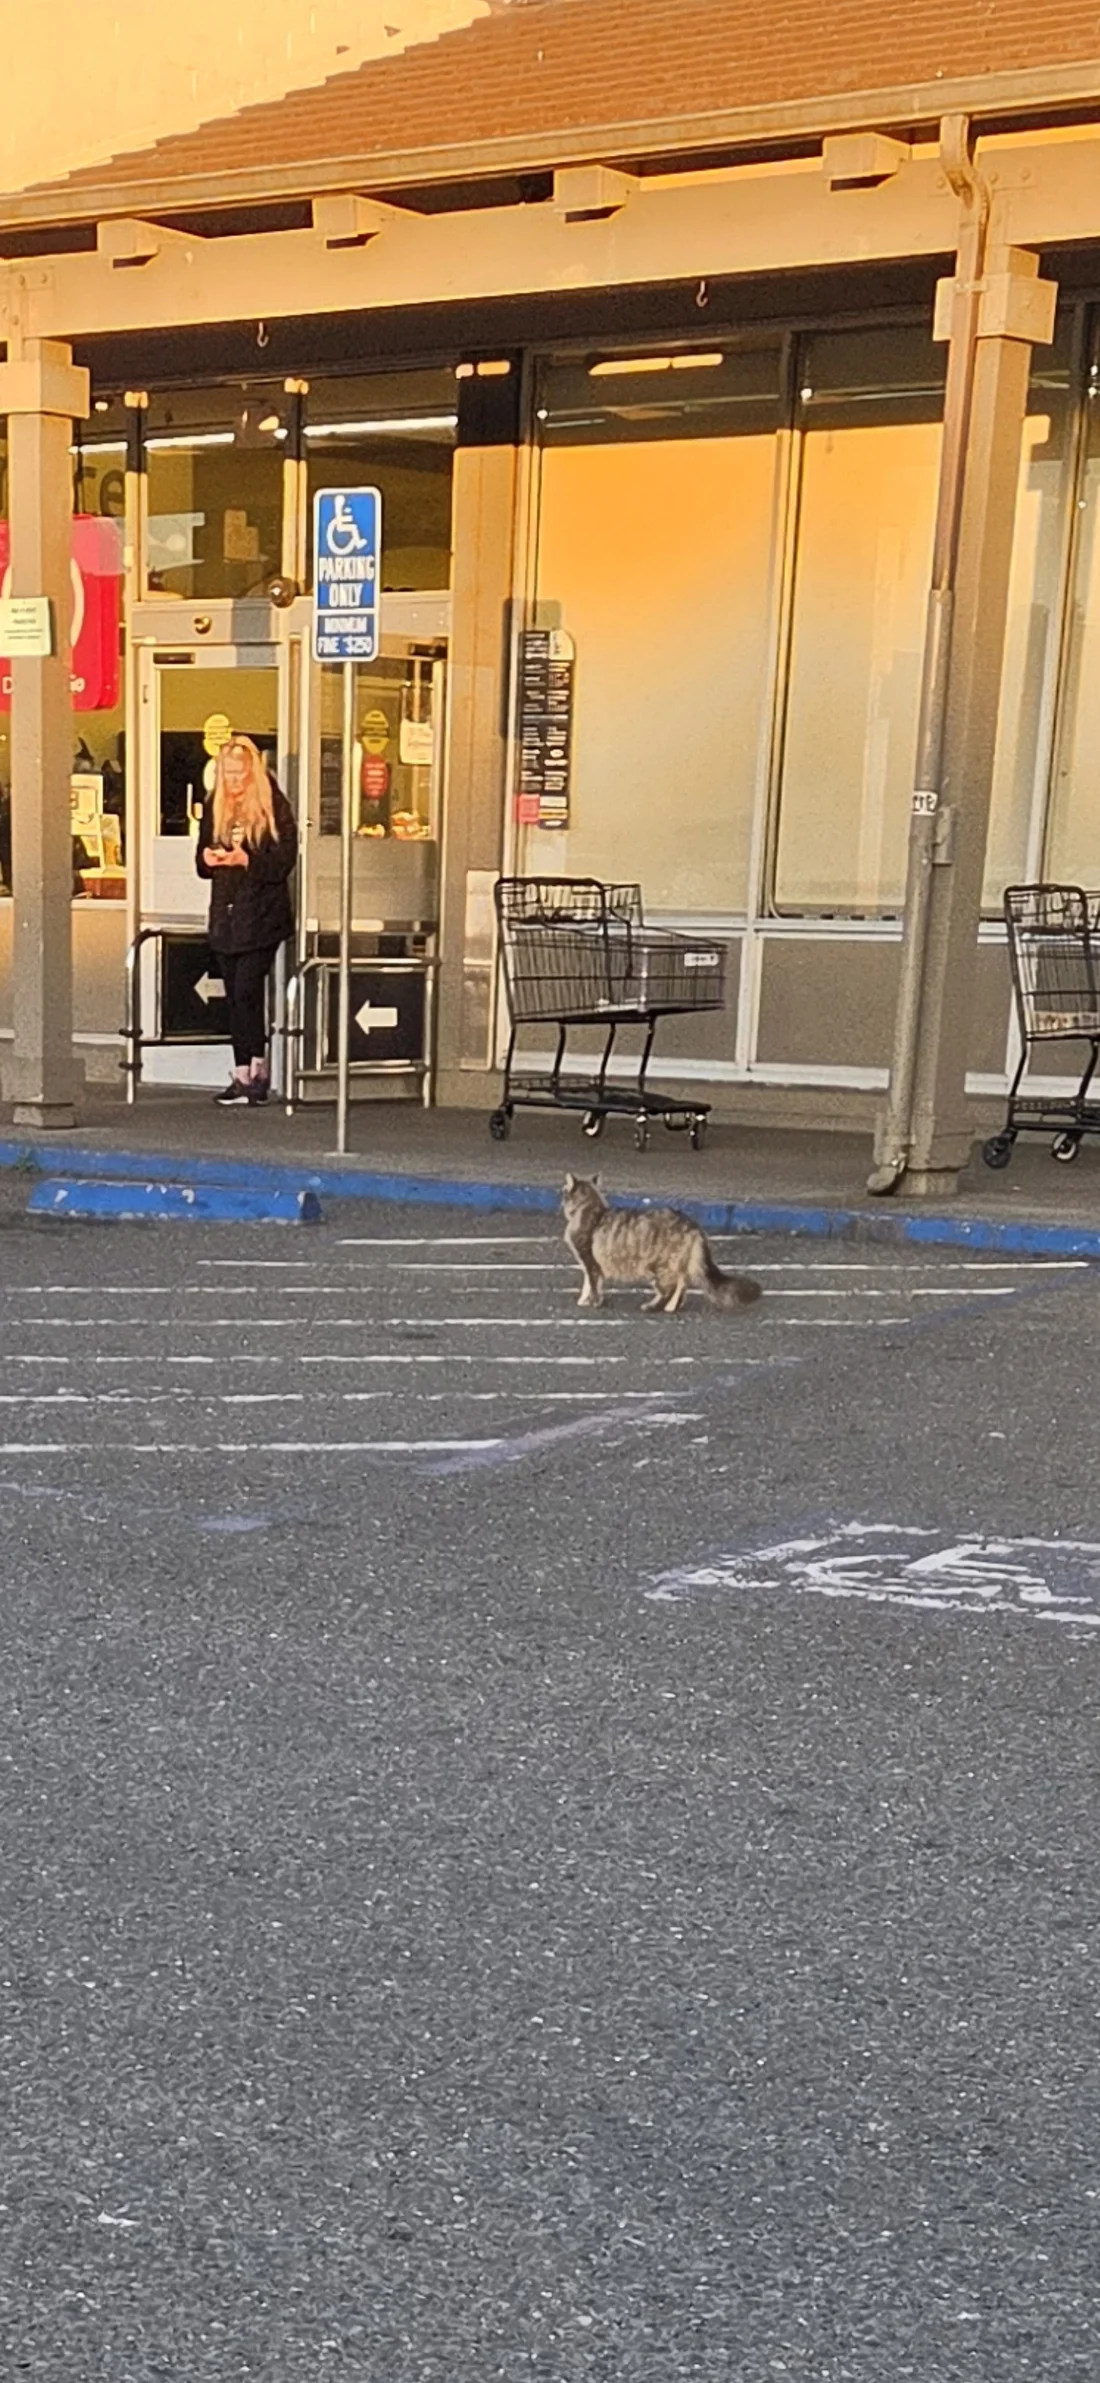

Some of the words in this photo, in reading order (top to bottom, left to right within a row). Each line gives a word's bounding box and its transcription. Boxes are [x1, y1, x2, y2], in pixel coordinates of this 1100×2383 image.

[319, 556, 374, 581] PARKING
[328, 583, 363, 607] ONLY
[318, 636, 340, 653] FINE
[342, 635, 373, 654] $250
